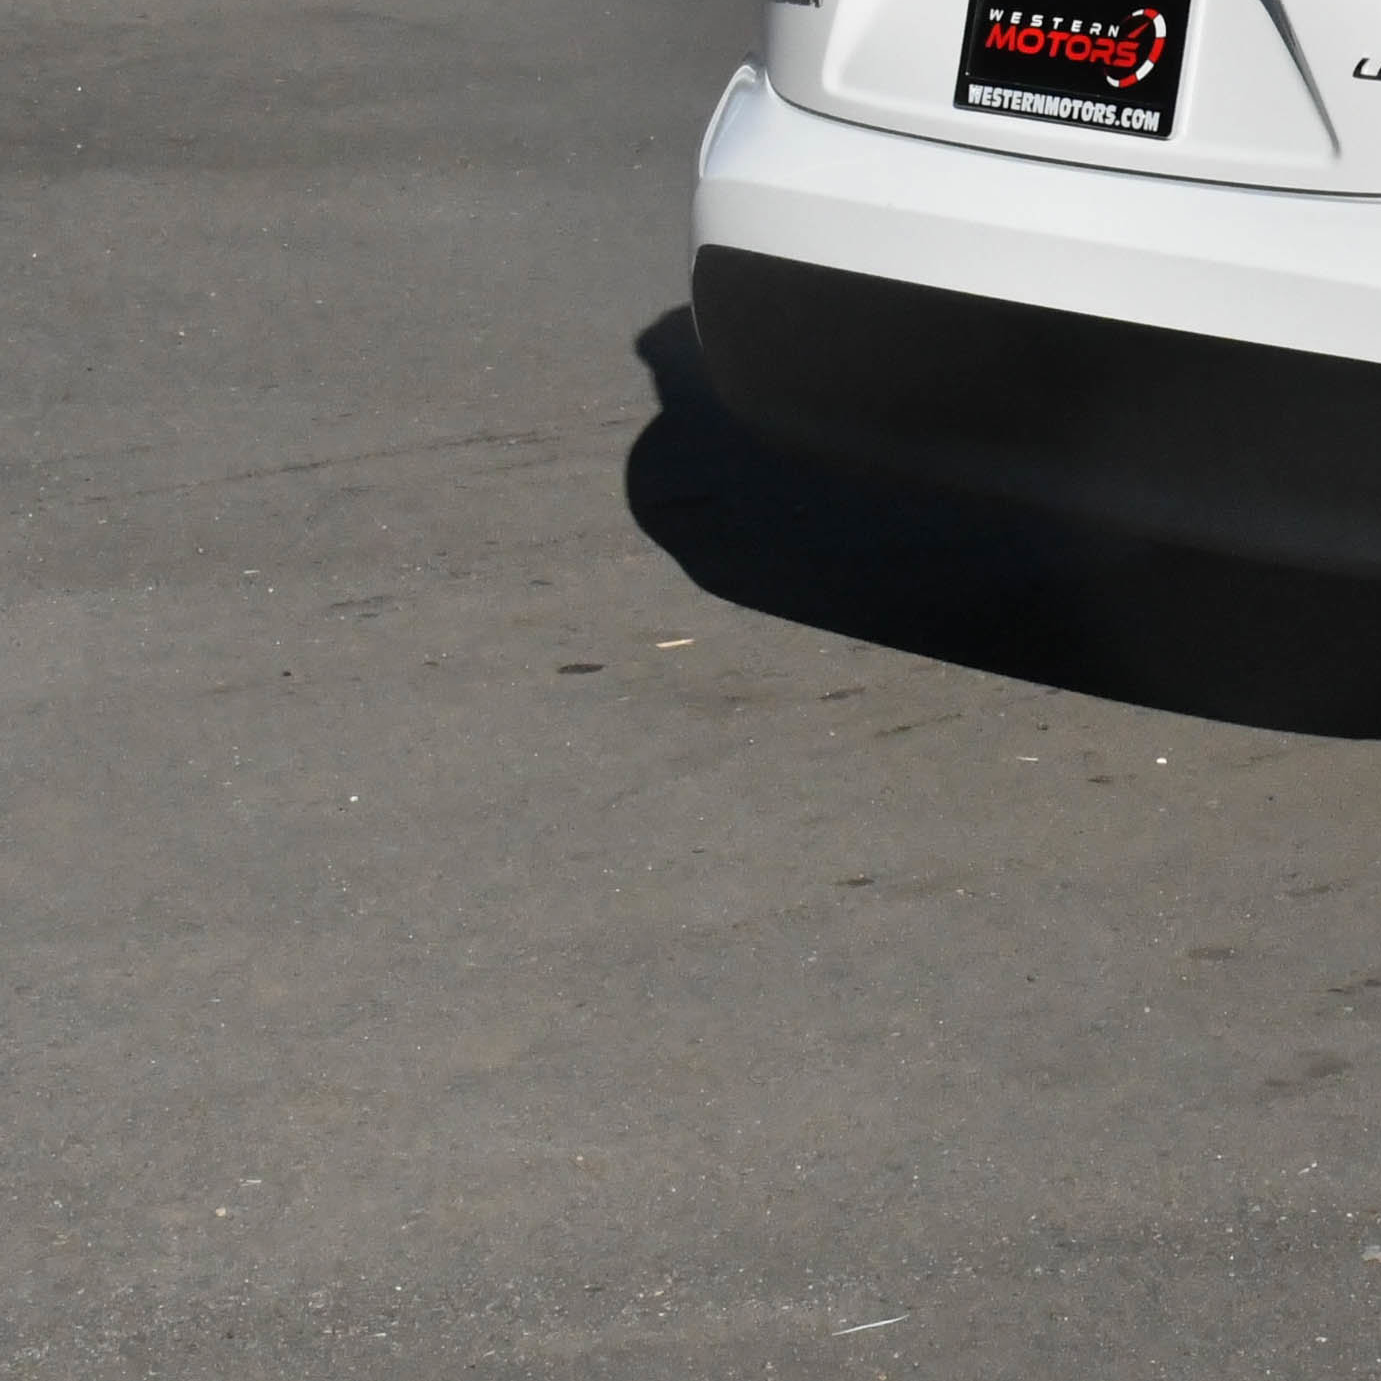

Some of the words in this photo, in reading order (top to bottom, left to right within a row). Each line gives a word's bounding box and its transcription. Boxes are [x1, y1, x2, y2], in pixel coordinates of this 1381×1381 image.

[985, 23, 1140, 68] MOTORS
[989, 8, 1120, 38] WESTERN
[967, 83, 1160, 132] WESTERNMOTORS.COM
